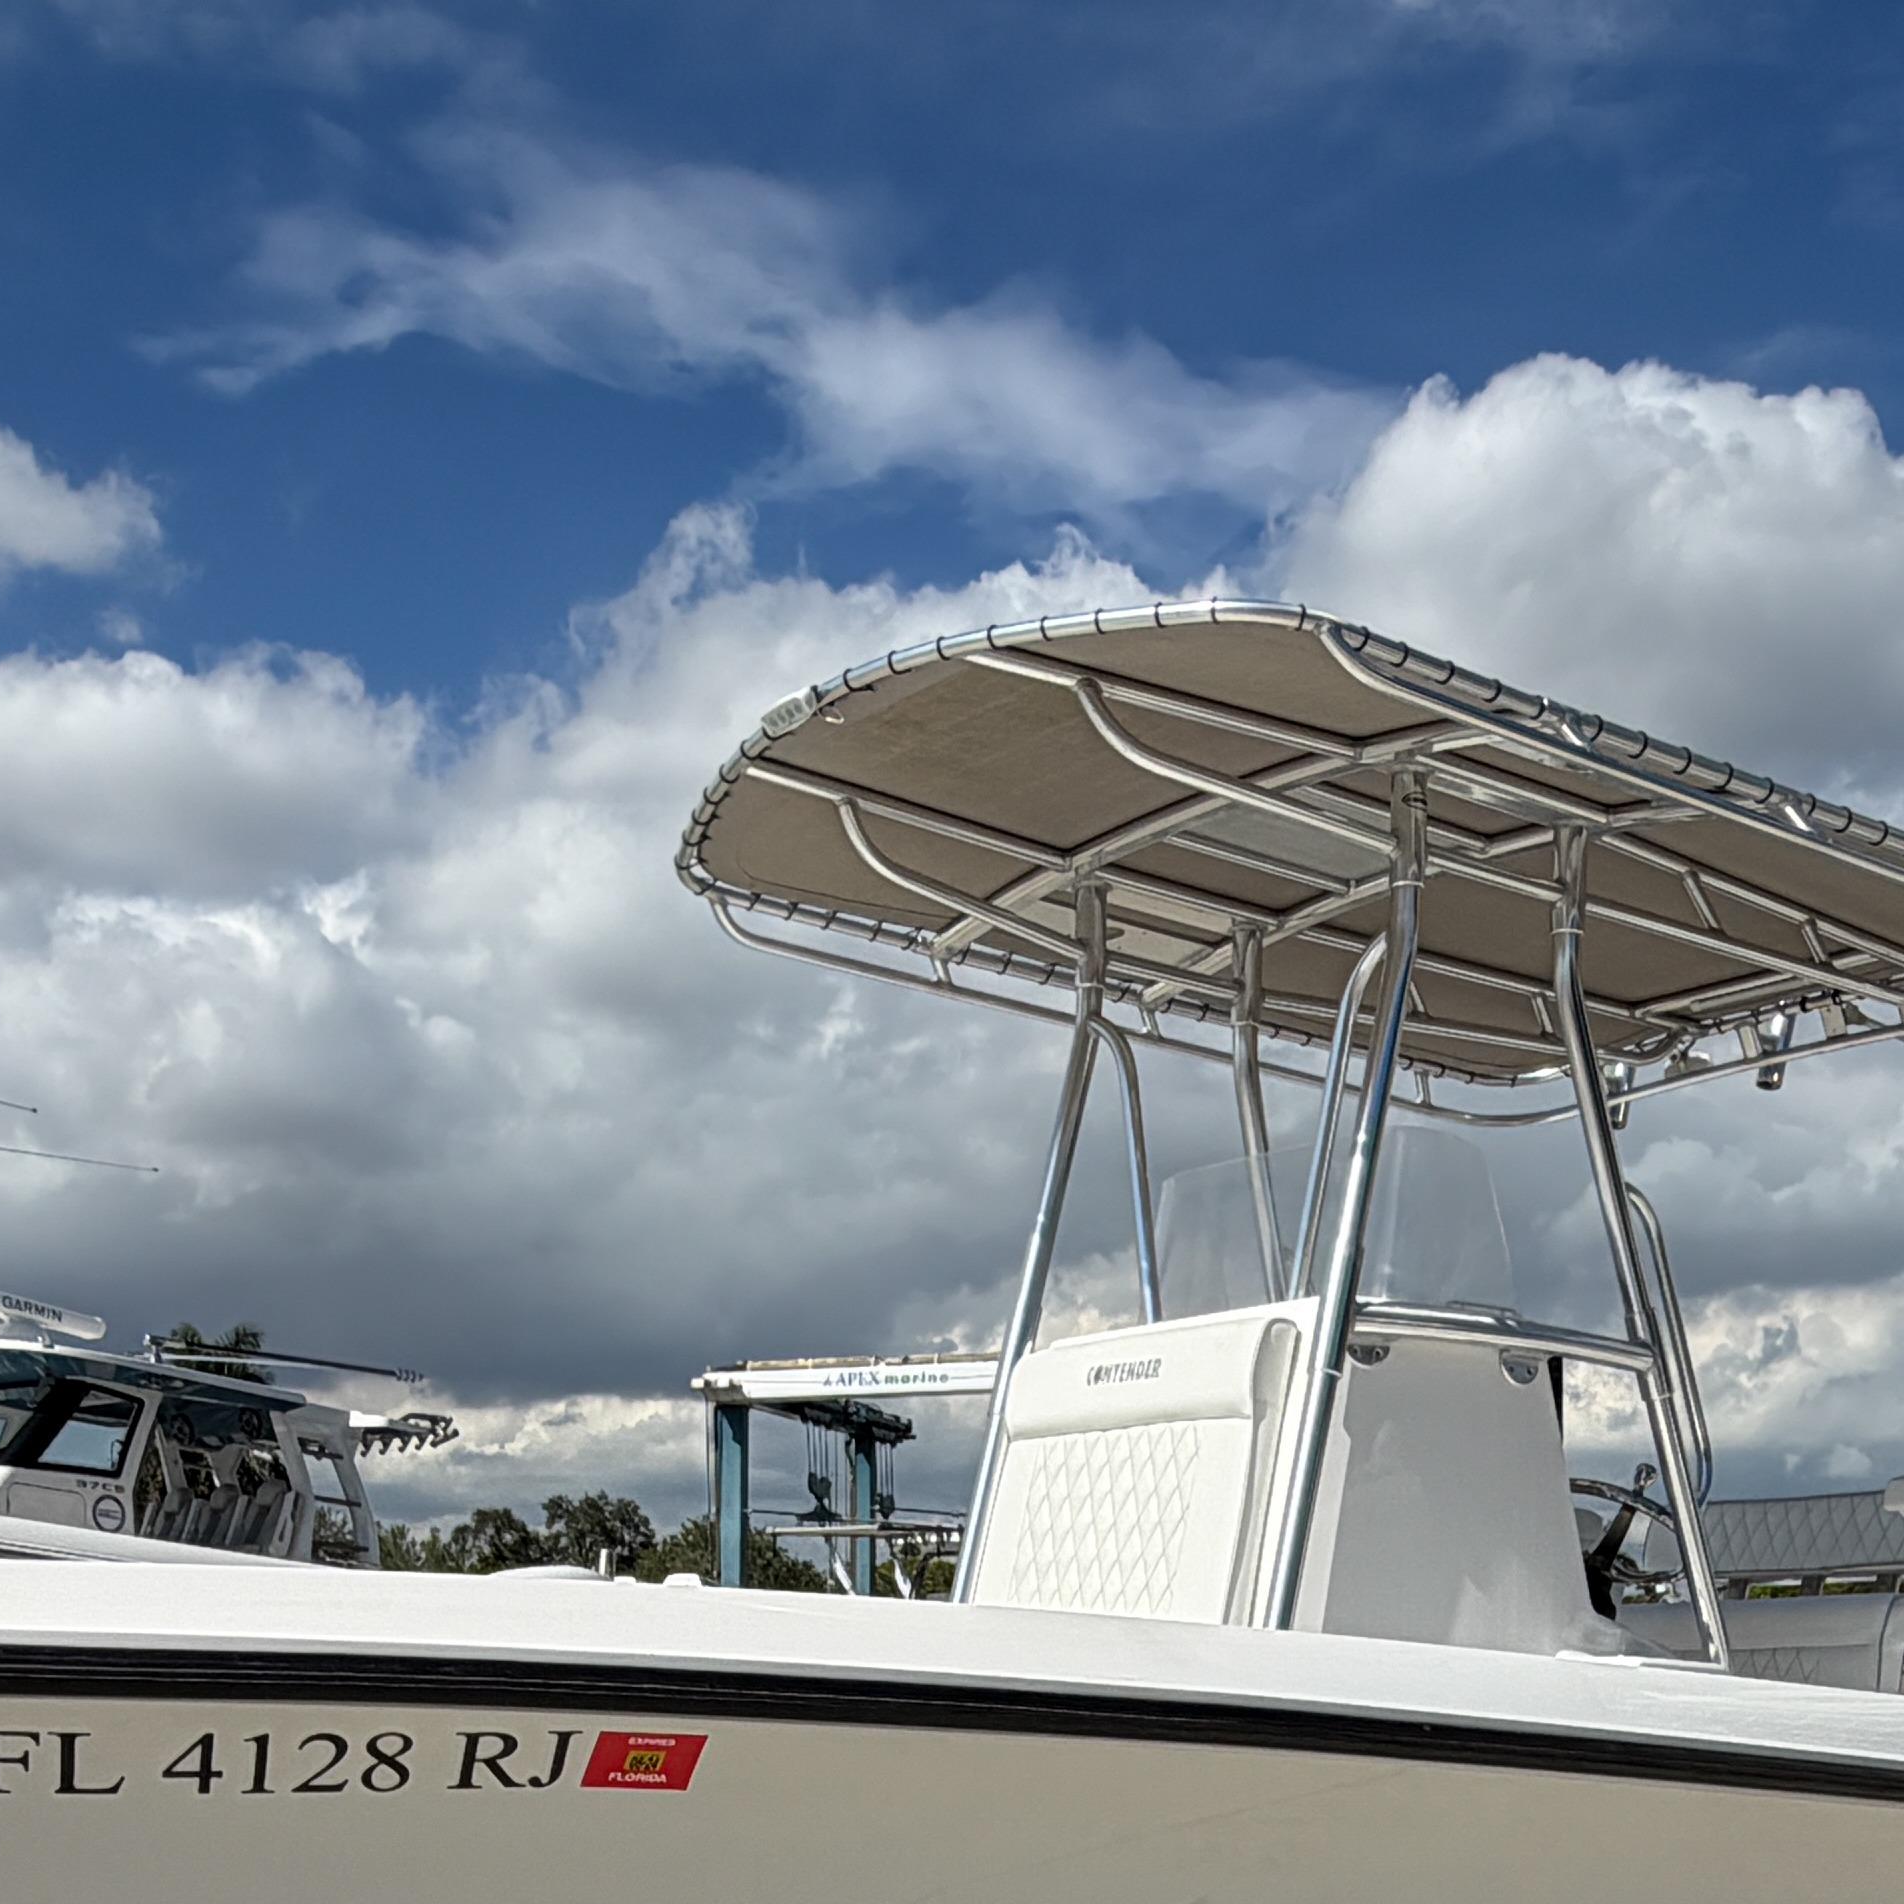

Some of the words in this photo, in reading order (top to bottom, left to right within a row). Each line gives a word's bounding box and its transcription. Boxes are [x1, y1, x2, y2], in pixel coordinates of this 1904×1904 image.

[1, 1295, 63, 1322] GARMIN
[835, 1371, 880, 1387] APEX
[884, 1370, 950, 1385] marine
[1086, 1358, 1162, 1386] CONTENDER
[161, 1731, 414, 1795] 4128
[446, 1729, 584, 1791] RJ
[608, 1771, 667, 1783] FLORIDA
